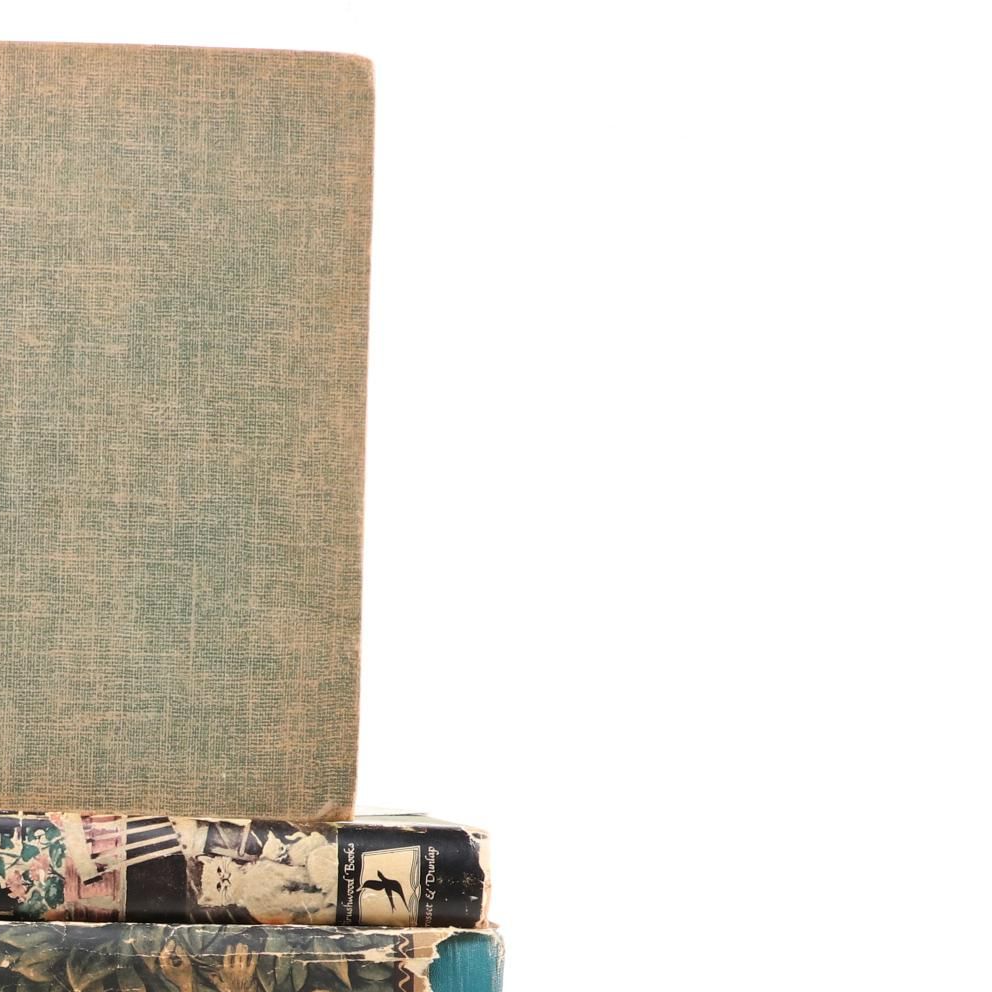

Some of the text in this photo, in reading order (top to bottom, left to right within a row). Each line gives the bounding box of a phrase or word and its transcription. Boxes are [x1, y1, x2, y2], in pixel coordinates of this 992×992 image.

[341, 843, 355, 924] rushwood Books
[424, 846, 440, 928] rosset & Dunlap
